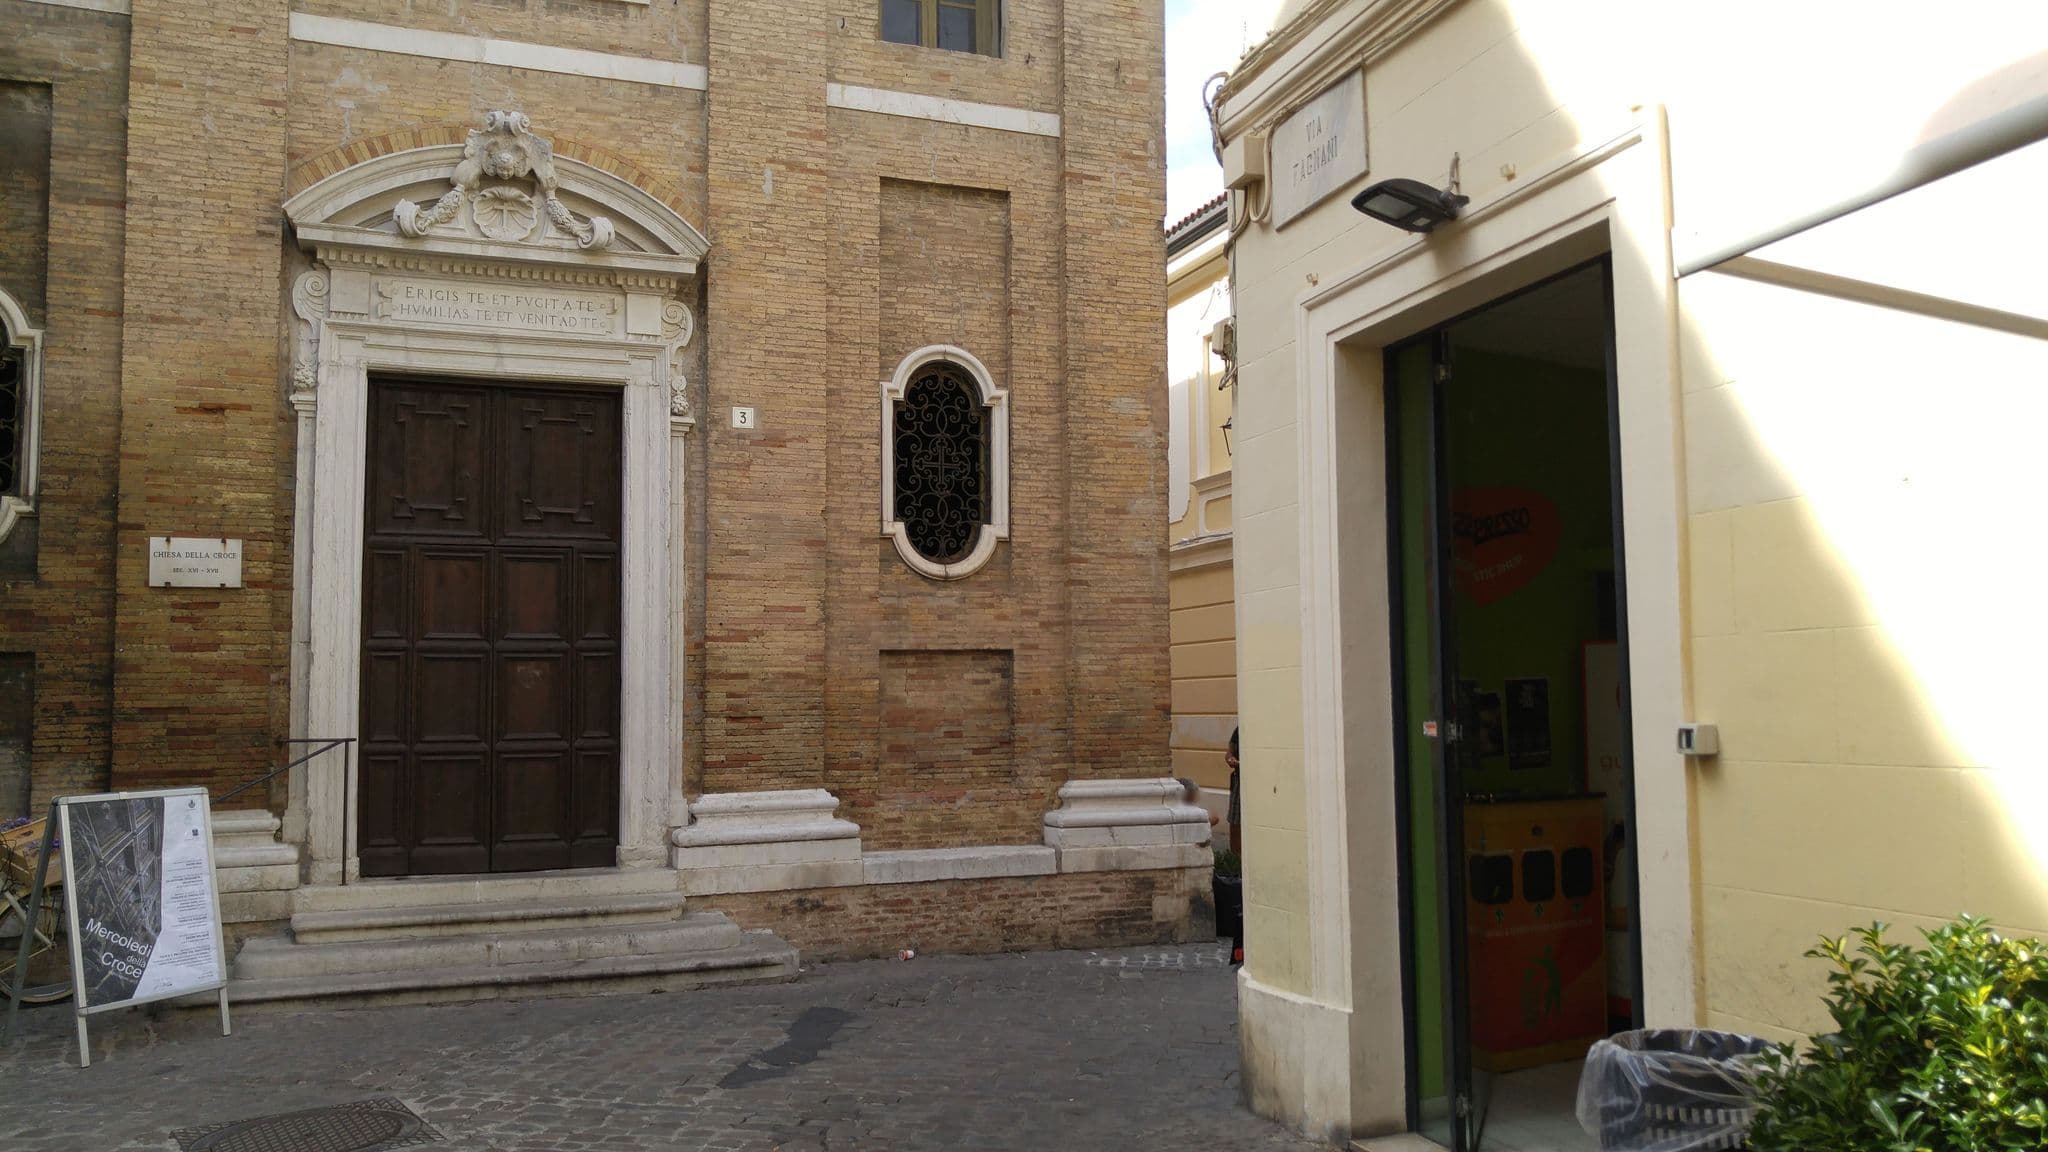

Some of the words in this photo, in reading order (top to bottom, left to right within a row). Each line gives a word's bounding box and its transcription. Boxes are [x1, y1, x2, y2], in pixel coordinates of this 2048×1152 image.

[1305, 115, 1322, 142] VIA
[405, 286, 459, 302] ERIGIS
[467, 292, 485, 304] TE
[492, 294, 510, 306] ET
[563, 300, 573, 310] A
[576, 300, 595, 312] TE
[400, 303, 469, 319] HVMILIAS
[475, 309, 492, 321] TE
[497, 310, 513, 322] ET
[518, 312, 558, 326] VENIT
[559, 316, 577, 327] AD
[580, 317, 598, 329] TE
[739, 411, 747, 424] 3
[153, 551, 182, 559] CHIESA
[185, 551, 210, 559] DELLA
[213, 552, 238, 560] CROCE
[101, 951, 142, 978] Croce
[126, 955, 146, 968] della
